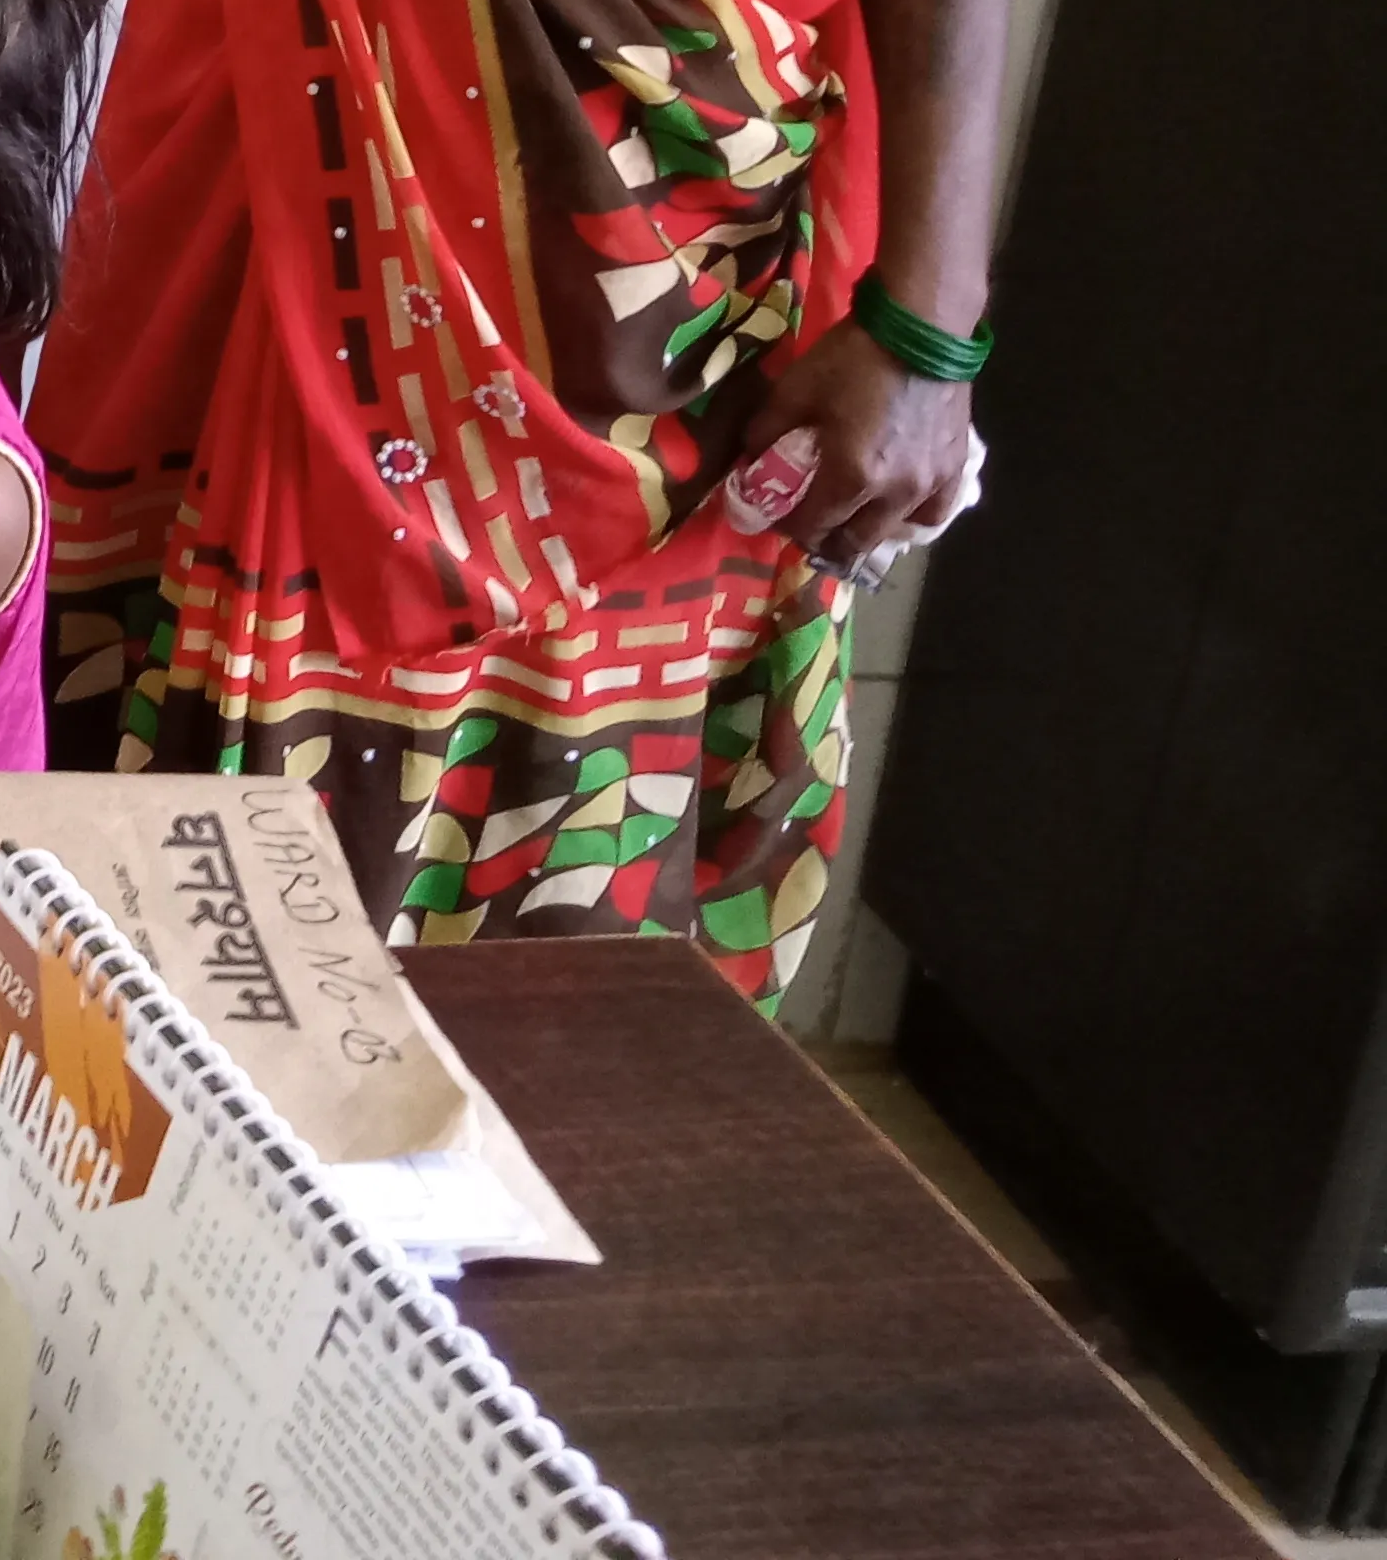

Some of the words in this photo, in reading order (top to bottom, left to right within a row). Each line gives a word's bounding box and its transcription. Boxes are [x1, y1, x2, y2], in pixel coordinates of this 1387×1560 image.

[241, 789, 340, 924] WARD
[161, 810, 300, 1030] घनश्याम
[32, 1244, 46, 1272] 2
[37, 1337, 55, 1375] 10
[65, 1377, 81, 1413] 11
